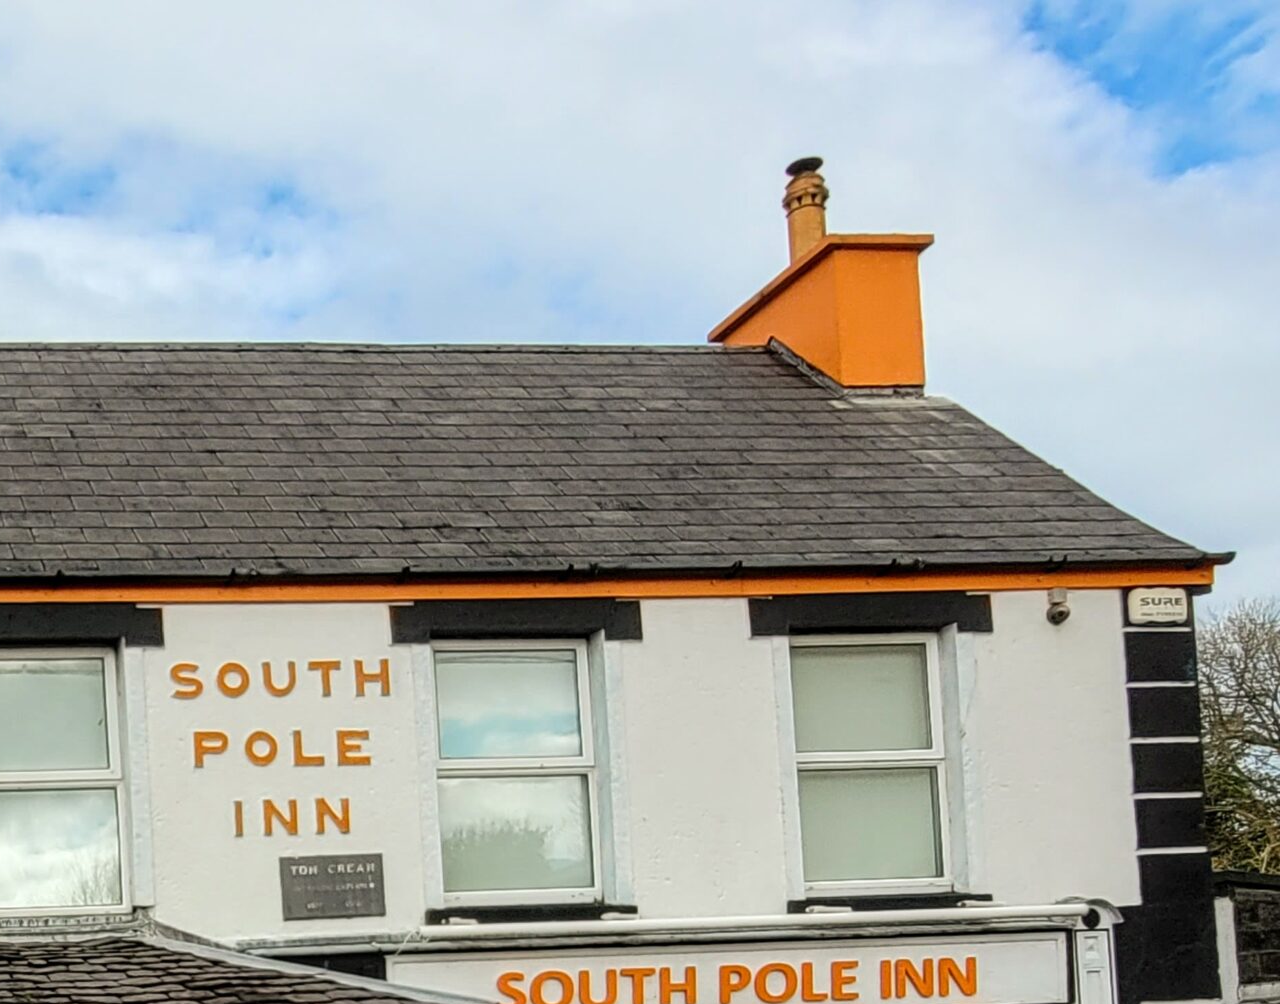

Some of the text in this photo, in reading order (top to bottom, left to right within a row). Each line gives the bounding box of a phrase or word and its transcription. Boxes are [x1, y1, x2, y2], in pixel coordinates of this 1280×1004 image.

[1140, 597, 1183, 606] SURE
[169, 659, 390, 699] SOUTH
[193, 730, 371, 768] POLE
[233, 798, 350, 838] INN
[720, 961, 859, 1004] POLE
[880, 957, 977, 999] INN
